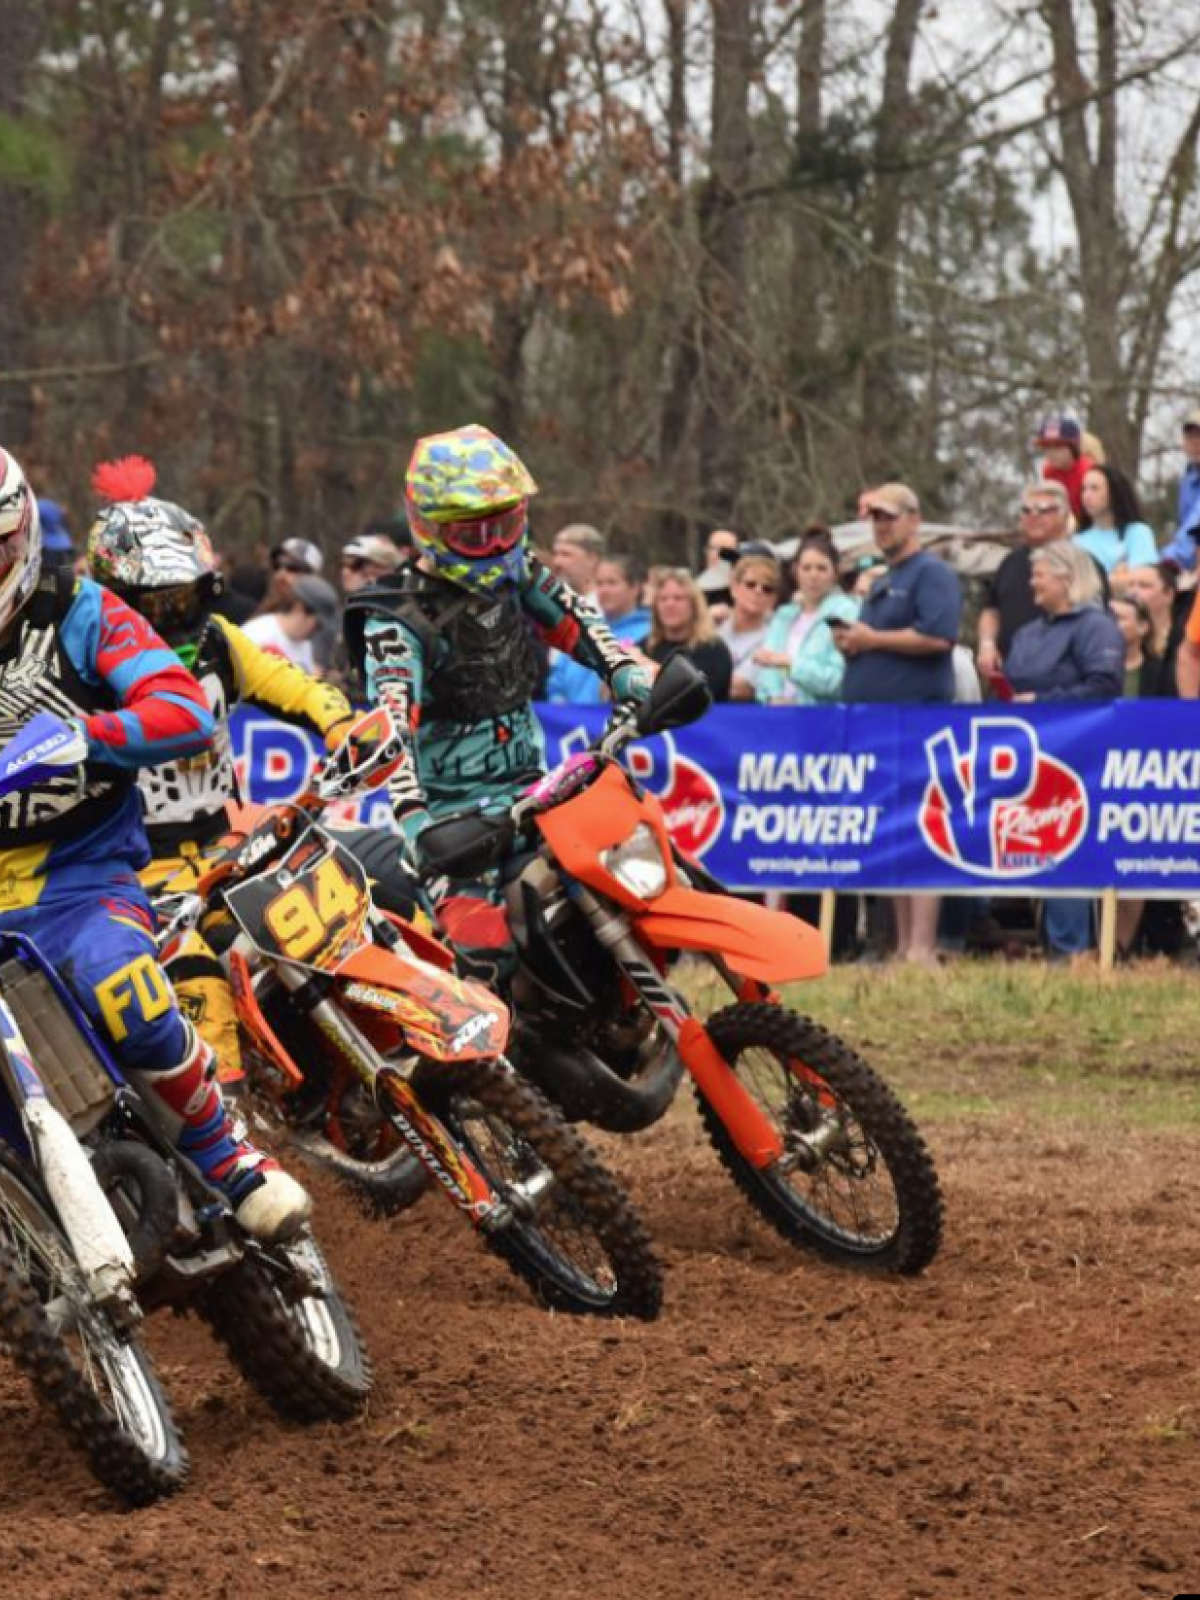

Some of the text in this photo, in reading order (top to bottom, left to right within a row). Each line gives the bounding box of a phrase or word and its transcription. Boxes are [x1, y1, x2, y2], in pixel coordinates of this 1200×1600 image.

[738, 753, 877, 793] MAKIN'
[1101, 749, 1200, 790] MAKI
[924, 716, 1039, 877] VP
[731, 804, 878, 845] POWER!
[1097, 802, 1200, 844] POWE
[264, 855, 362, 962] 94
[391, 1114, 467, 1201] DUNLOP
